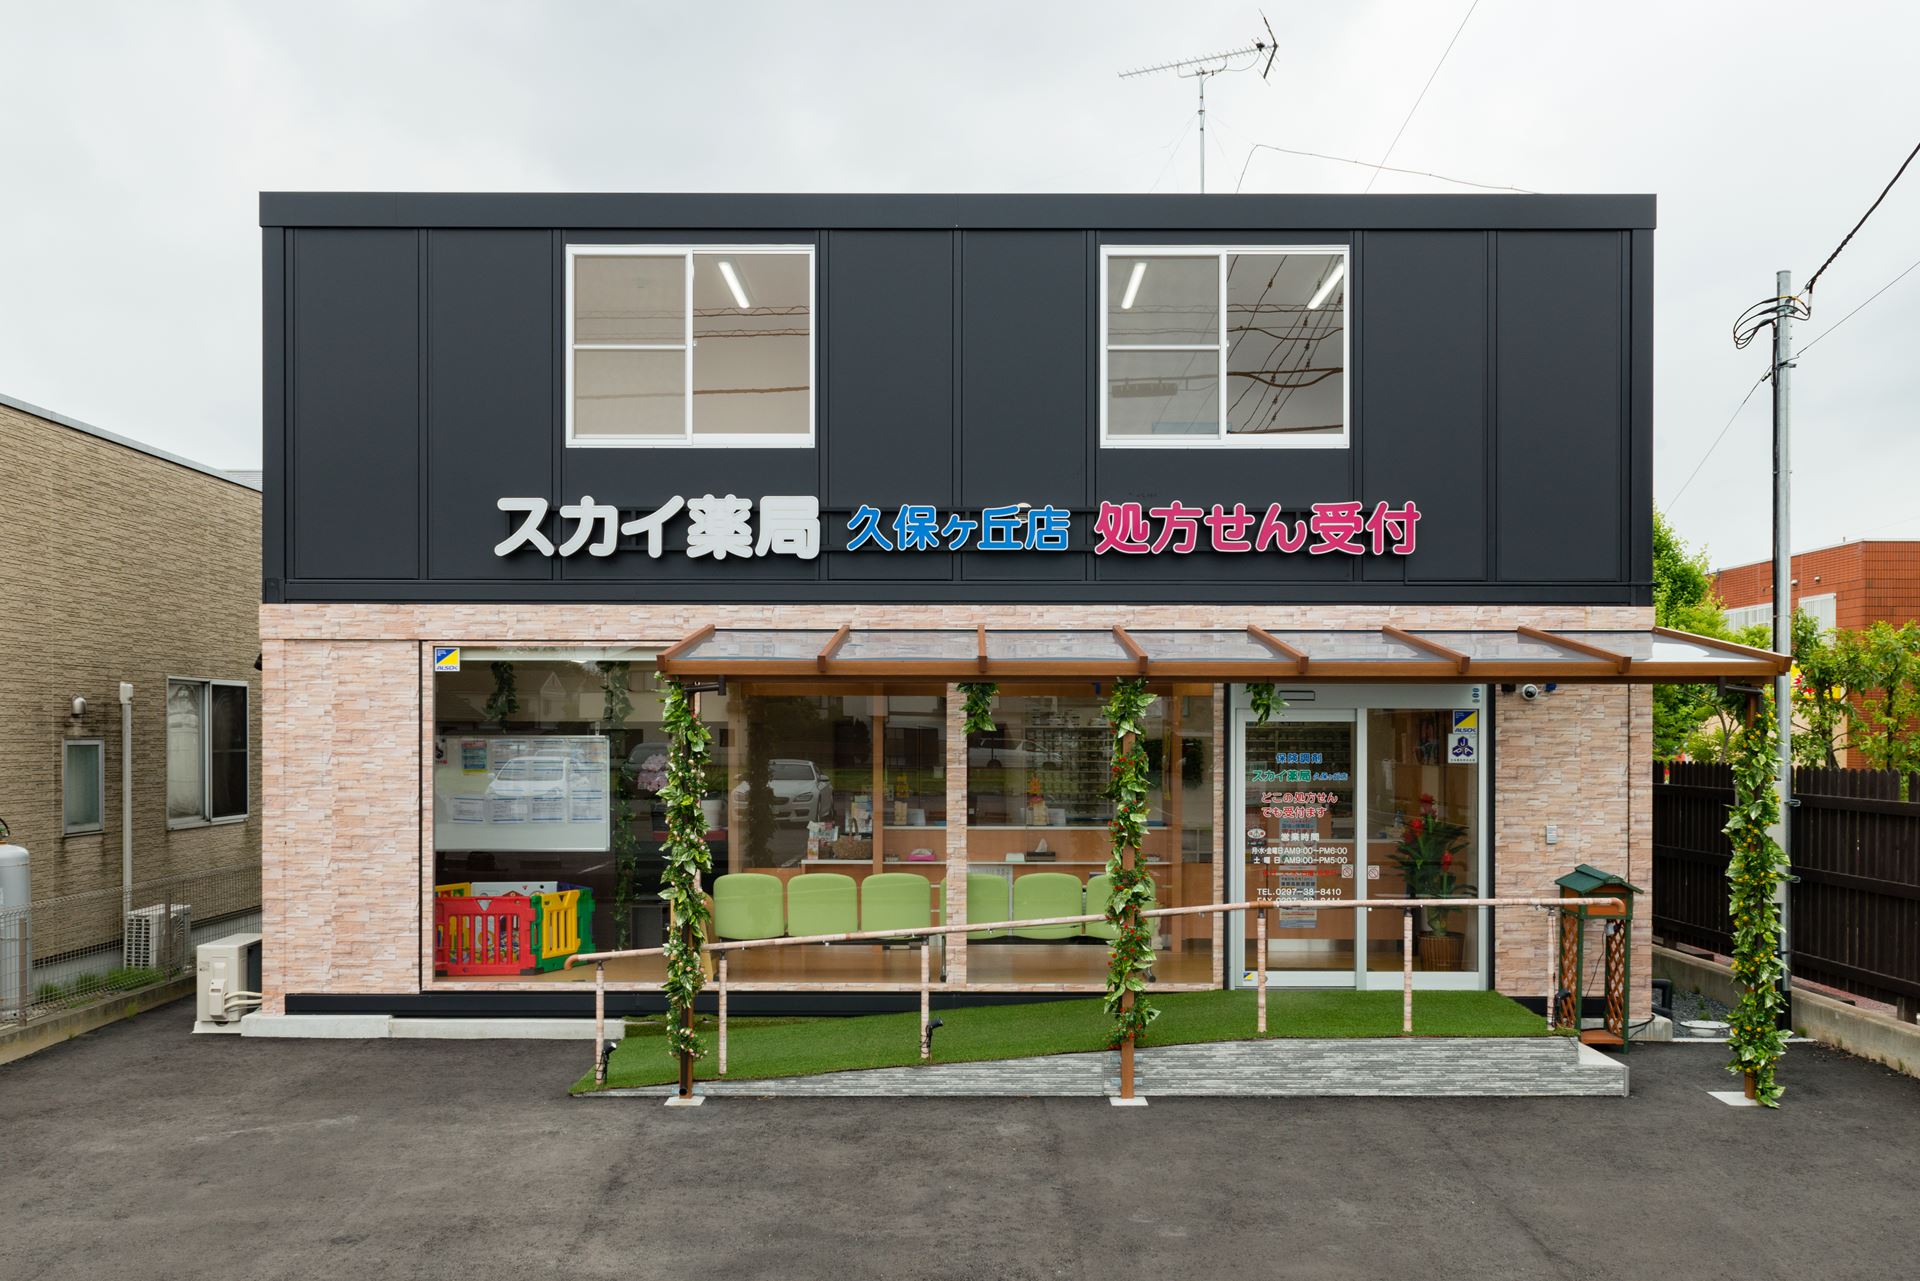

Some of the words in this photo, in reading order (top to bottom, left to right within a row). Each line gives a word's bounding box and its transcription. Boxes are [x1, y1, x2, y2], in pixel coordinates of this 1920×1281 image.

[494, 494, 821, 560] スカイ薬局
[847, 504, 1071, 551] 久保ヶ丘店
[1094, 501, 1422, 555] 処方せん受付
[1252, 769, 1311, 782] スカイ薬局
[1261, 792, 1338, 804] どこの処方せん
[1261, 806, 1328, 819] でも受付ます
[1281, 832, 1320, 842] 営業時間
